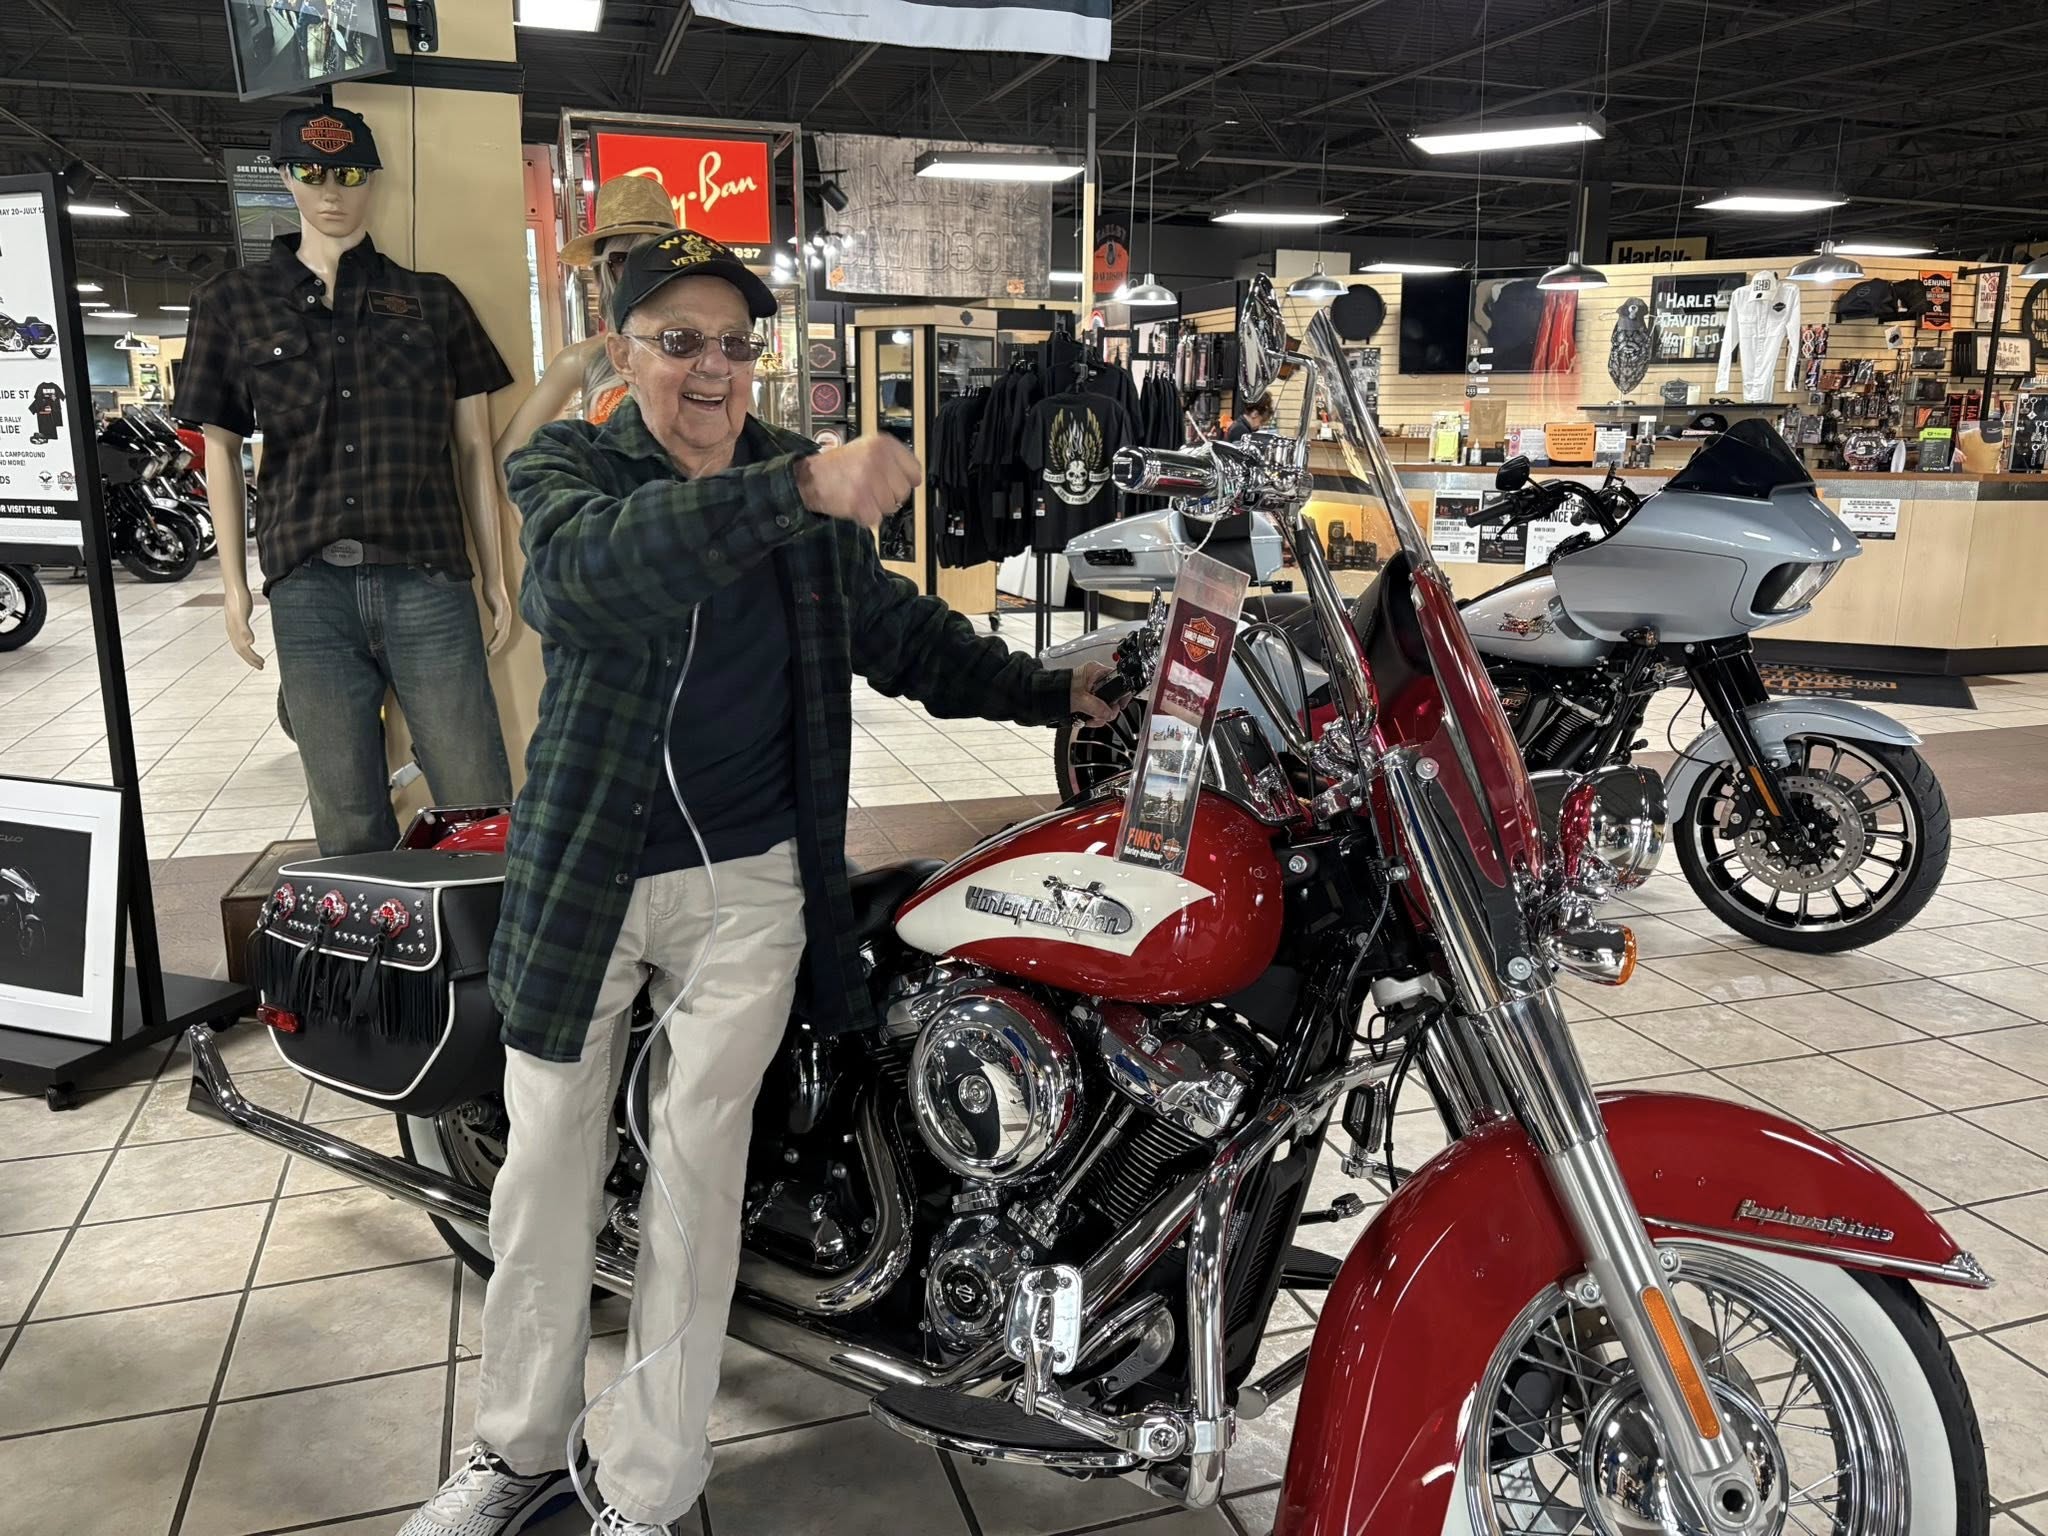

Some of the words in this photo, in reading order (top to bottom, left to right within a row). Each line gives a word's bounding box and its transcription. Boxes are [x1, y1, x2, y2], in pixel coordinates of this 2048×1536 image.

[312, 119, 340, 128] MOTOR
[303, 129, 351, 141] HARLEY-DAVIDSON
[236, 165, 250, 173] SEE
[11, 207, 37, 215] 20-JULY
[729, 247, 761, 259] 937
[834, 224, 1026, 274] DAVIDSON
[671, 255, 712, 267] VETER
[1923, 279, 1951, 287] GENUINE
[1665, 292, 1723, 308] HARLEY
[1662, 312, 1727, 328] DAVIDSON
[19, 390, 30, 400] ST
[6, 505, 26, 514] VISIT
[26, 506, 42, 515] THE
[42, 507, 58, 515] URL
[1126, 827, 1163, 851] FINK'S
[966, 885, 1121, 935] Harley-Davidson
